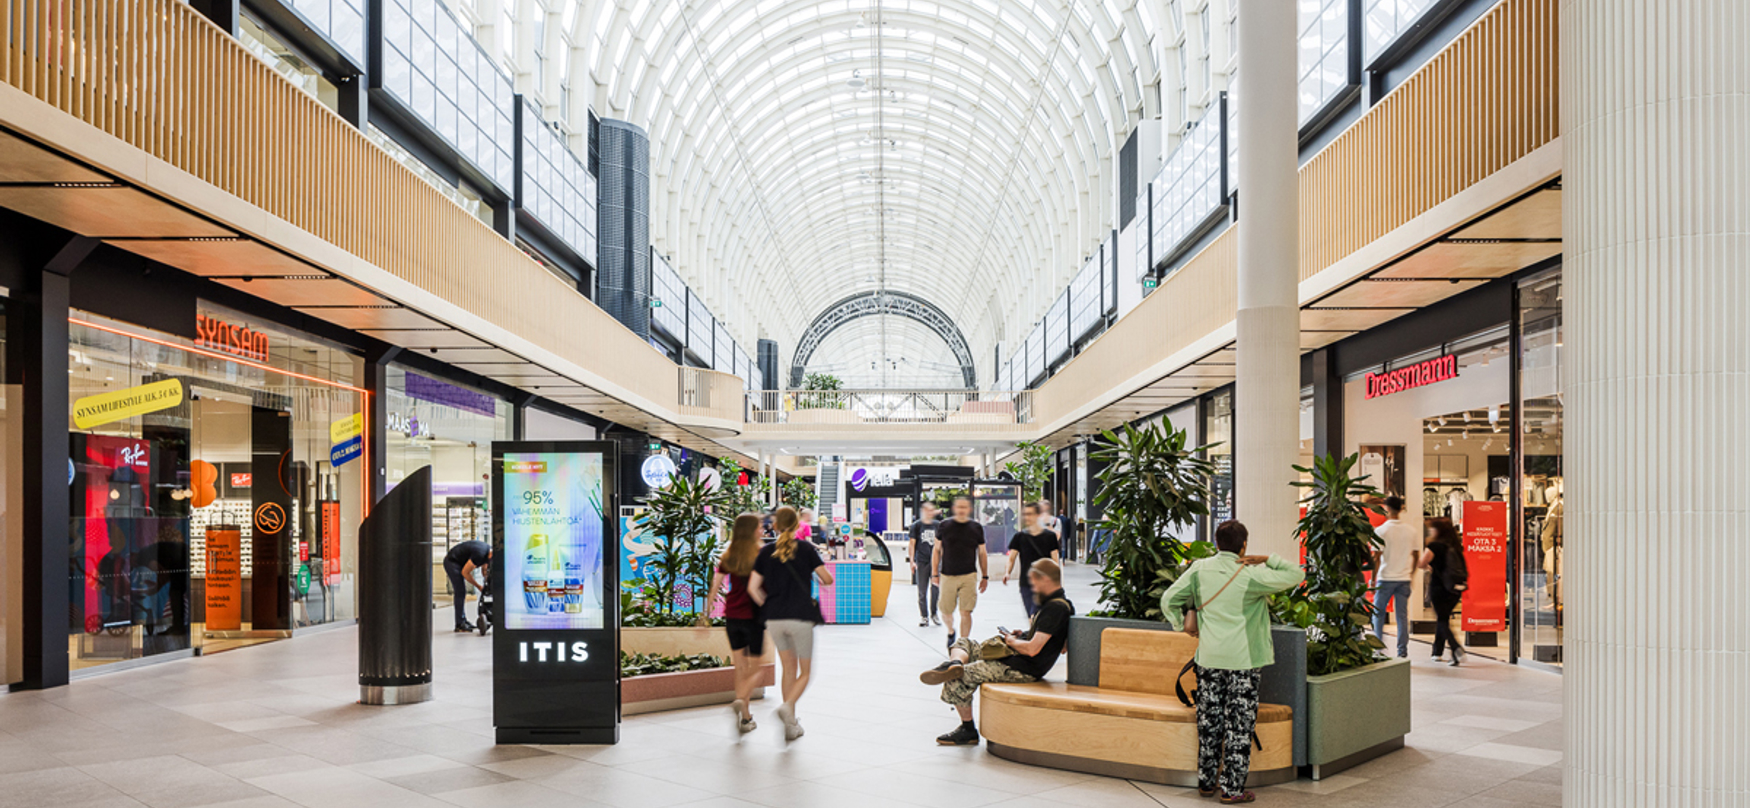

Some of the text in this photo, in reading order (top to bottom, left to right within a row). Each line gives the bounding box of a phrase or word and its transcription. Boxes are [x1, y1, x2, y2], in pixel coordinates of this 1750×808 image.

[194, 314, 269, 362] SYNSAM
[1364, 353, 1457, 400] Dressmann
[76, 402, 109, 419] SYNSAM
[109, 395, 142, 411] LIFESTYLE
[385, 411, 430, 438] MÄASEMA
[523, 490, 554, 505] 95%
[519, 641, 589, 662] ITIS
